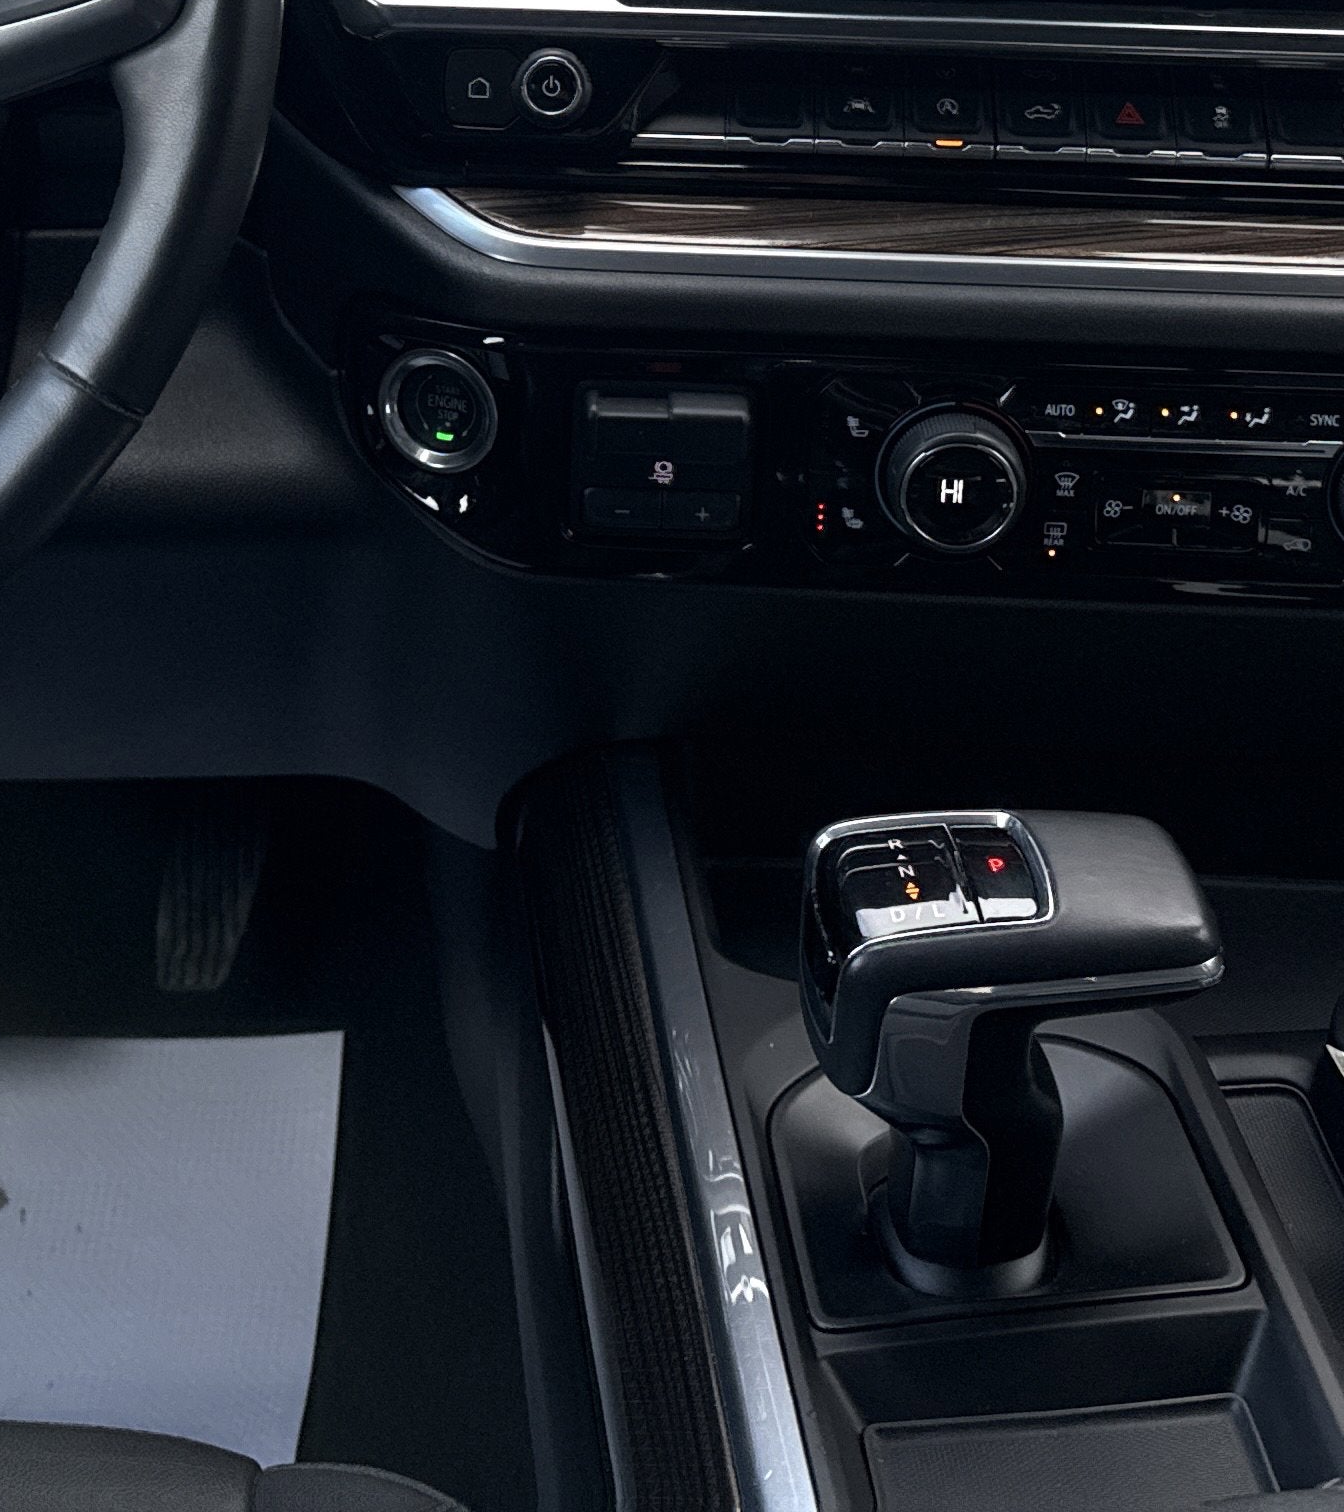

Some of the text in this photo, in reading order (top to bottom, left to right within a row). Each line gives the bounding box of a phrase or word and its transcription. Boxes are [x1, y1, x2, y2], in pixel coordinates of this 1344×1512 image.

[428, 394, 468, 413] ENGINE
[1045, 403, 1076, 417] AUTO
[438, 410, 459, 420] STOP
[1309, 414, 1340, 427] SYNC
[940, 479, 963, 504] HI
[1286, 485, 1307, 497] A/C
[1156, 503, 1197, 516] ON/OFF
[887, 838, 904, 850] R
[898, 865, 916, 878] N
[988, 858, 1004, 872] P
